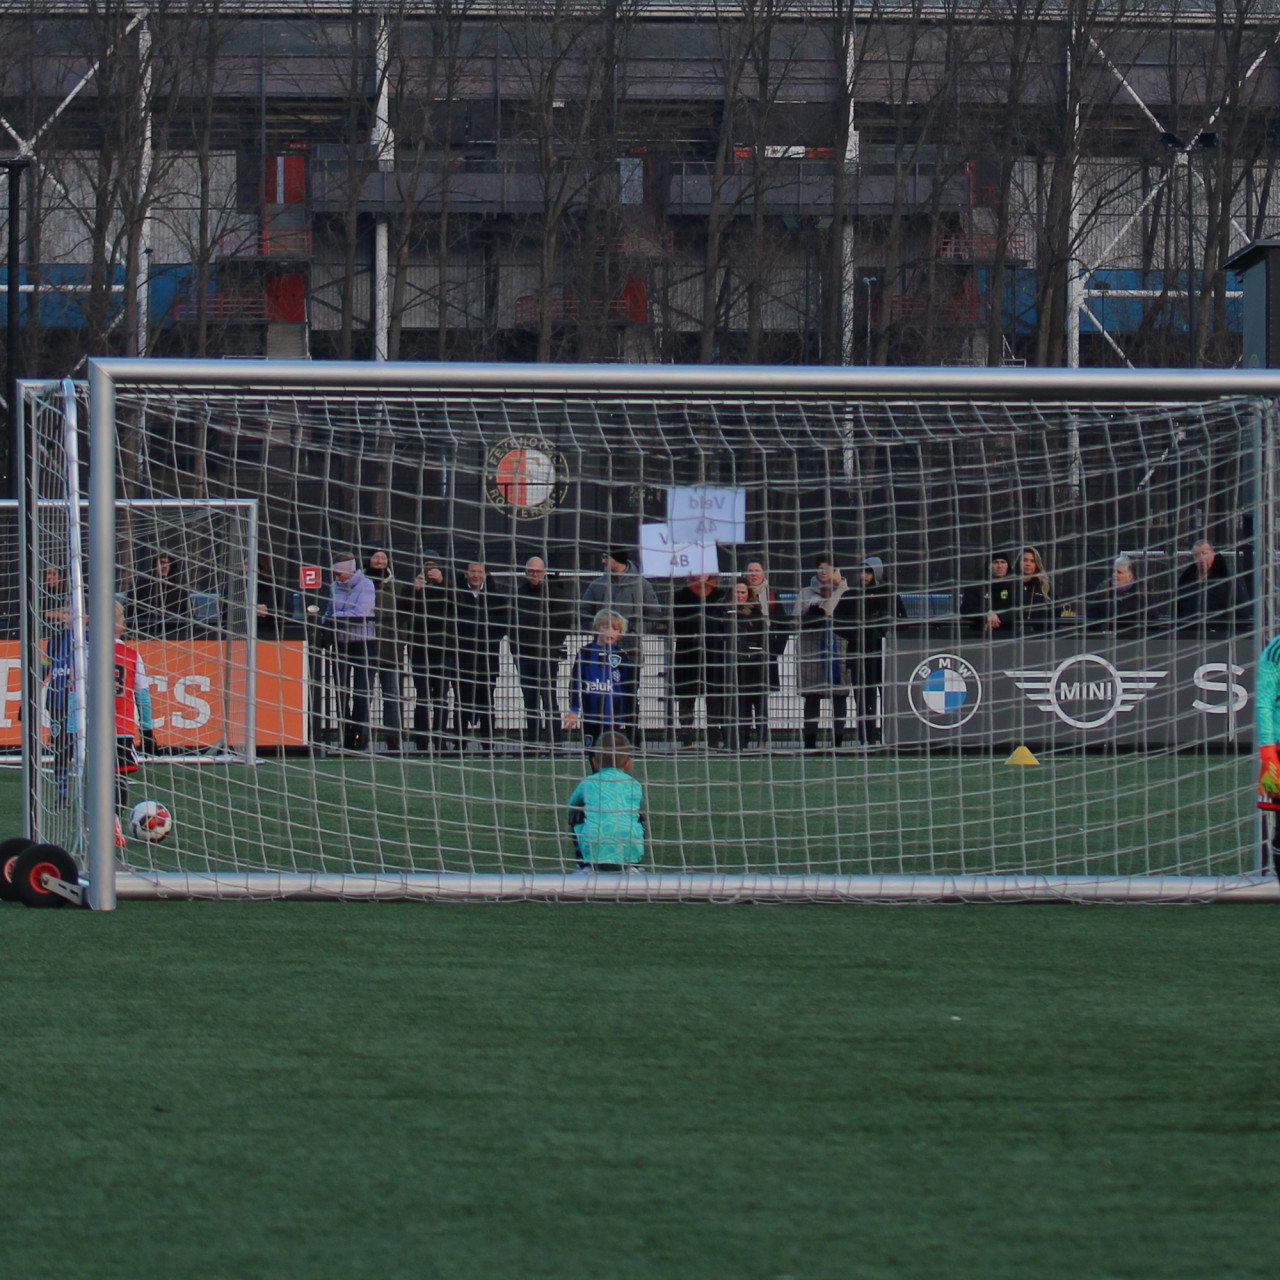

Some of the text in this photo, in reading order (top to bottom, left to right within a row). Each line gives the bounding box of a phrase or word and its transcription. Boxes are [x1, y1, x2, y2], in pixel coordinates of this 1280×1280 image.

[670, 554, 690, 568] 4B
[305, 570, 316, 584] 2
[917, 657, 972, 680] BMW
[1060, 681, 1112, 701] MINI
